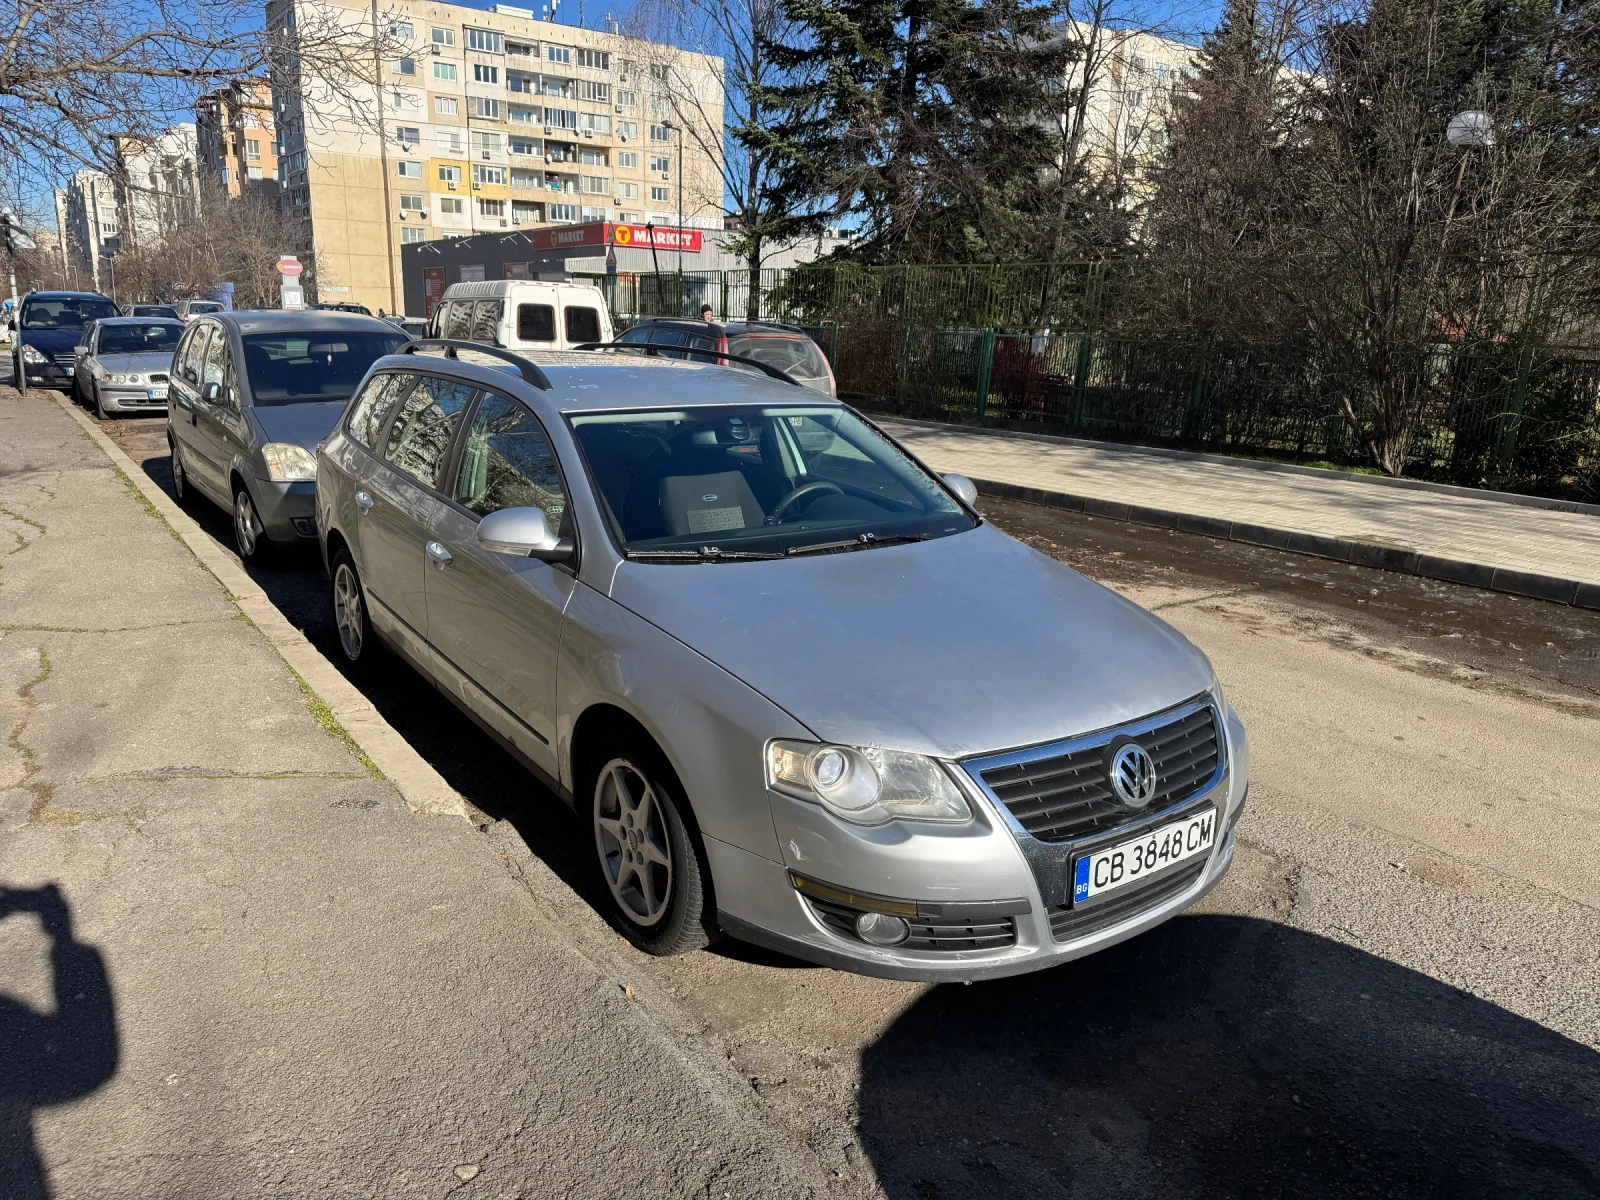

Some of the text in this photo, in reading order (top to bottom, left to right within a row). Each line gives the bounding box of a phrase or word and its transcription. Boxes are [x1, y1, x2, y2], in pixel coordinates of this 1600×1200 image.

[558, 229, 584, 244] MARKET
[633, 230, 692, 246] MARKET
[1076, 814, 1213, 894] BG CB 3848 CM
